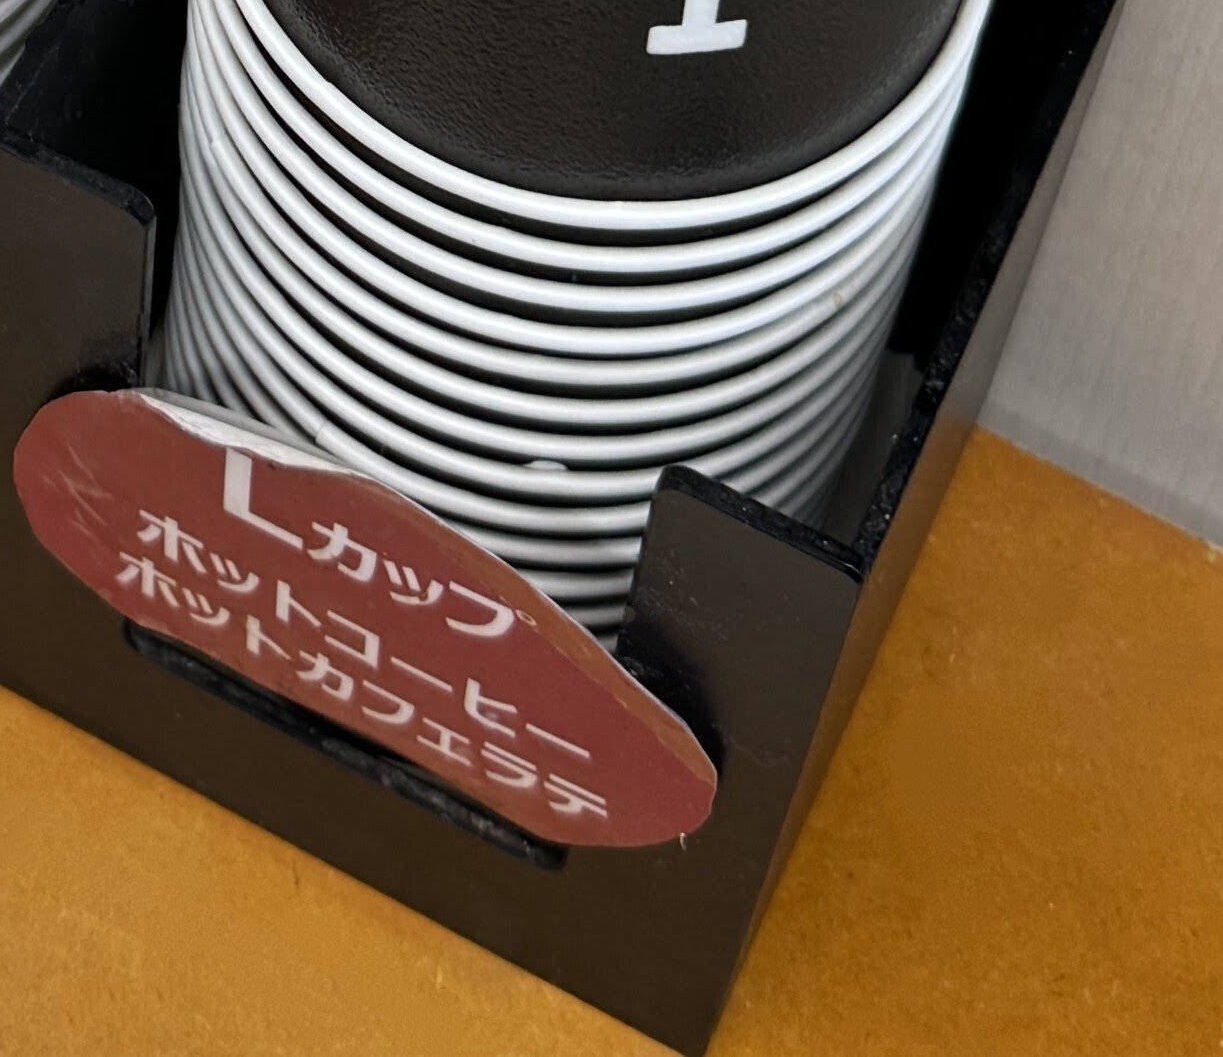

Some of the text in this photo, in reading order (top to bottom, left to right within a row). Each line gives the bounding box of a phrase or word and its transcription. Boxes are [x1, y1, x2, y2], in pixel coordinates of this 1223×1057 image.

[115, 551, 608, 819] ホットカフェラテ
[137, 508, 592, 761] ホットコーヒー
